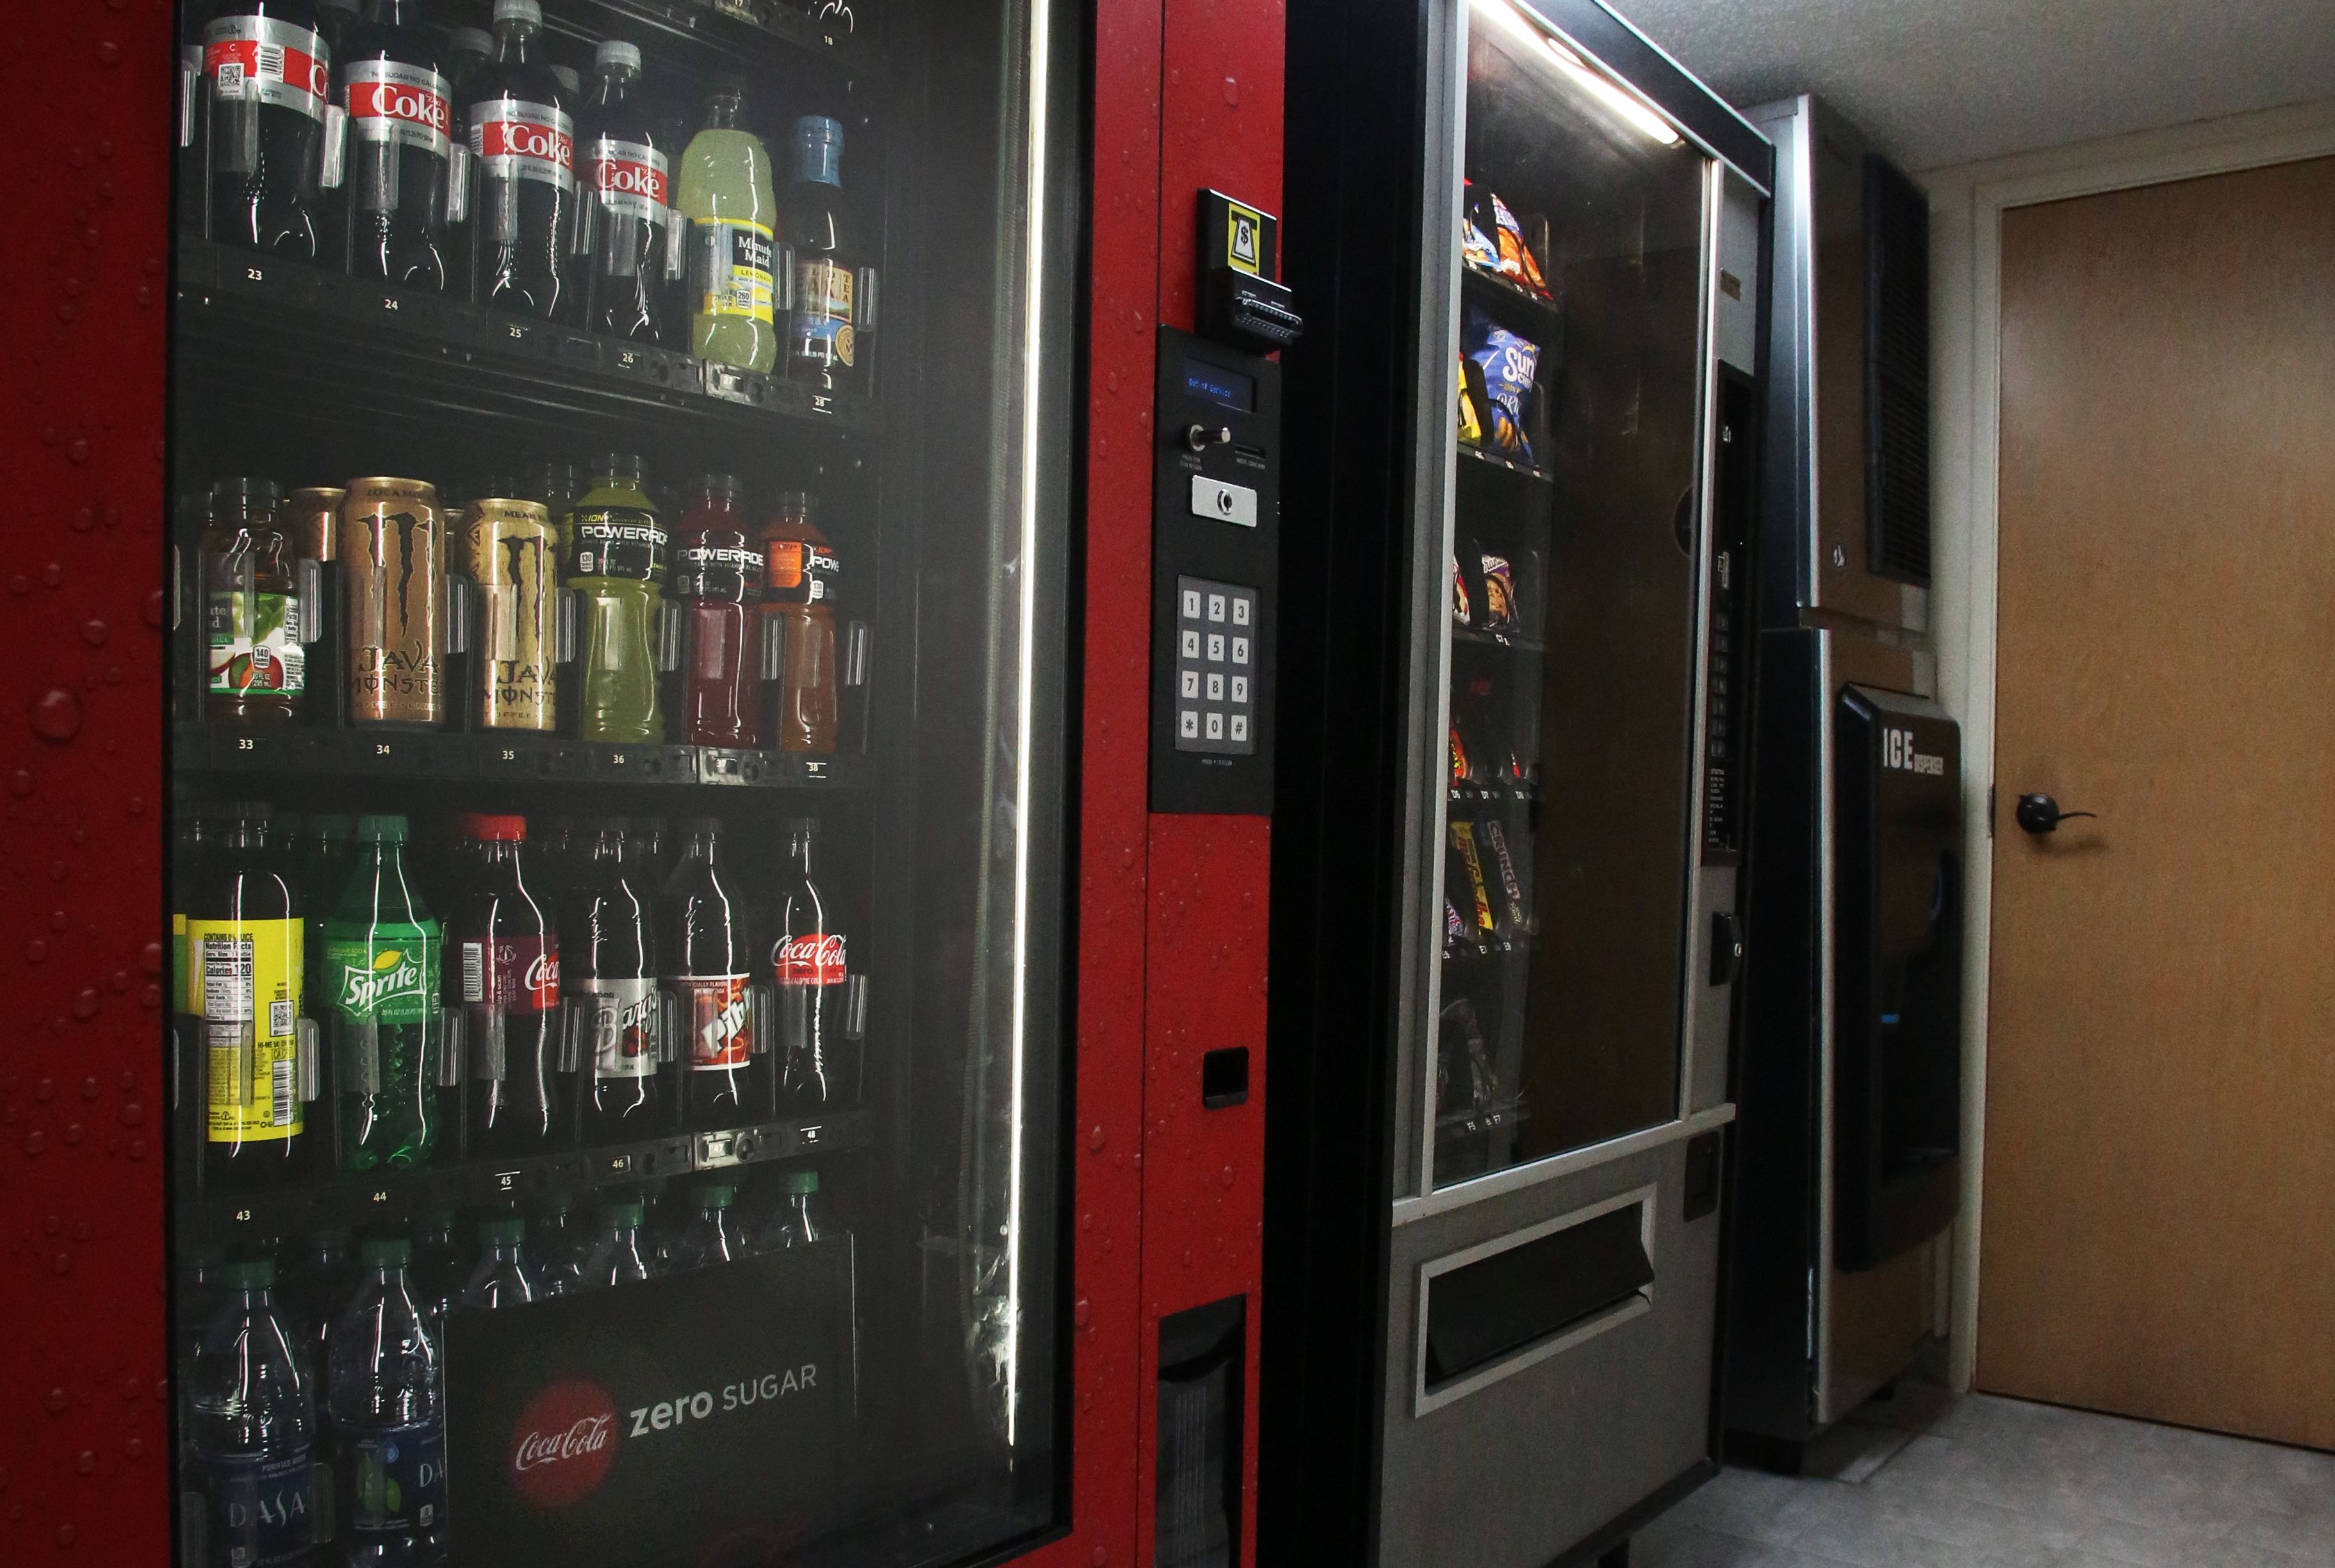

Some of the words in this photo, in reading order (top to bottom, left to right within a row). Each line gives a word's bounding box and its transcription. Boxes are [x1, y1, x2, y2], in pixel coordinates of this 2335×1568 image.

[824, 35, 833, 45] 18
[372, 85, 445, 129] Coke
[505, 124, 571, 167] Coke
[594, 161, 660, 199] Coke
[738, 236, 773, 259] Minute
[744, 249, 771, 269] Maid
[248, 268, 262, 281] 23
[737, 291, 750, 300] 260
[385, 299, 398, 310] 24
[510, 327, 522, 338] 25
[623, 353, 634, 364] 26
[1502, 346, 1535, 383] Sun
[815, 396, 825, 407] 28
[677, 548, 764, 567] POWERADE
[1189, 598, 1194, 612] 1
[1213, 601, 1220, 615] 2
[1238, 605, 1245, 619] 3
[256, 648, 269, 658] 140
[1188, 638, 1194, 651] 4
[1213, 641, 1220, 655] 5
[1237, 644, 1244, 658] 6
[358, 639, 440, 674] JAVA
[1187, 678, 1194, 691] 7
[1212, 680, 1219, 694] 8
[1236, 683, 1243, 696] 9
[1211, 719, 1218, 733] 0
[239, 739, 253, 749] 33
[377, 744, 390, 755] 34
[1883, 728, 1913, 770] ICE
[503, 750, 514, 760] 35
[613, 755, 625, 764] 36
[808, 764, 819, 772] 38
[1489, 821, 1521, 899] CRUNCH
[770, 934, 847, 967] Coca-Cola
[205, 965, 233, 975] Calories
[345, 961, 418, 1008] Sprite
[807, 1130, 816, 1139] 48
[612, 1159, 624, 1168] 46
[500, 1176, 512, 1187] 45
[373, 1191, 387, 1202] 44
[236, 1210, 250, 1221] 43
[516, 1413, 615, 1471] Coca-Cola
[629, 1391, 714, 1439] zero
[723, 1364, 817, 1411] SUGAR
